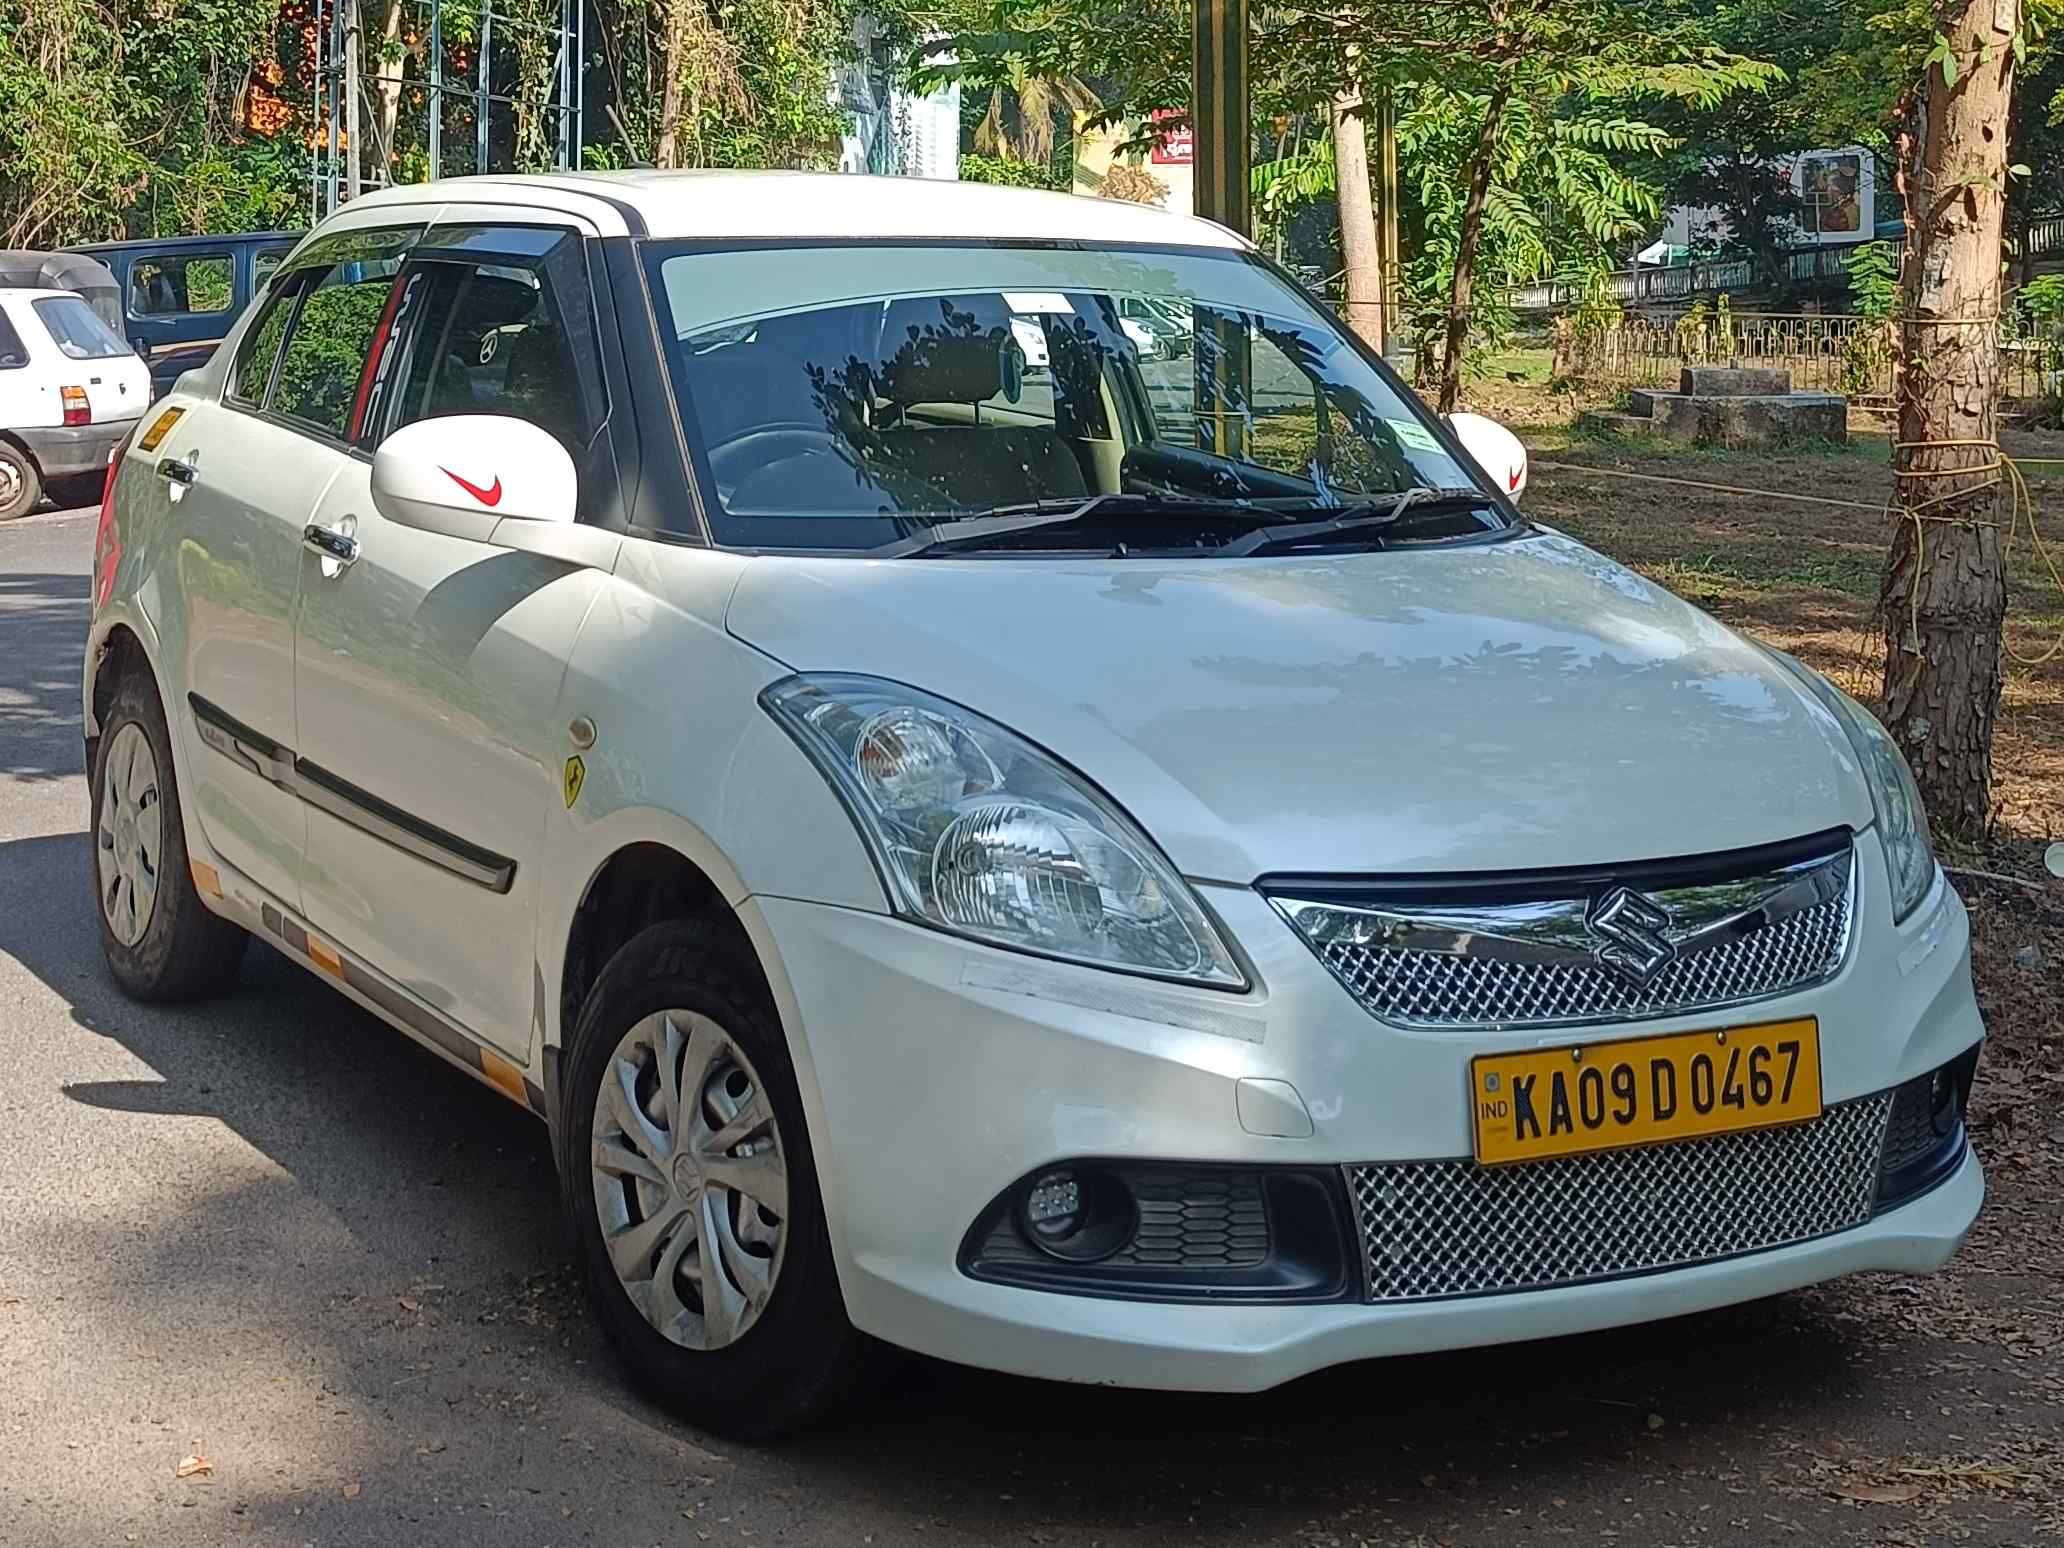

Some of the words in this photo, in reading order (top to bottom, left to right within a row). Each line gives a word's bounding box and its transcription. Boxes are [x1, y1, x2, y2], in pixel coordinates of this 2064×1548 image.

[1480, 1100, 1508, 1120] IND
[1511, 1063, 1637, 1141] KA09
[1650, 1058, 1677, 1122] D
[1690, 1040, 1801, 1115] 0467
